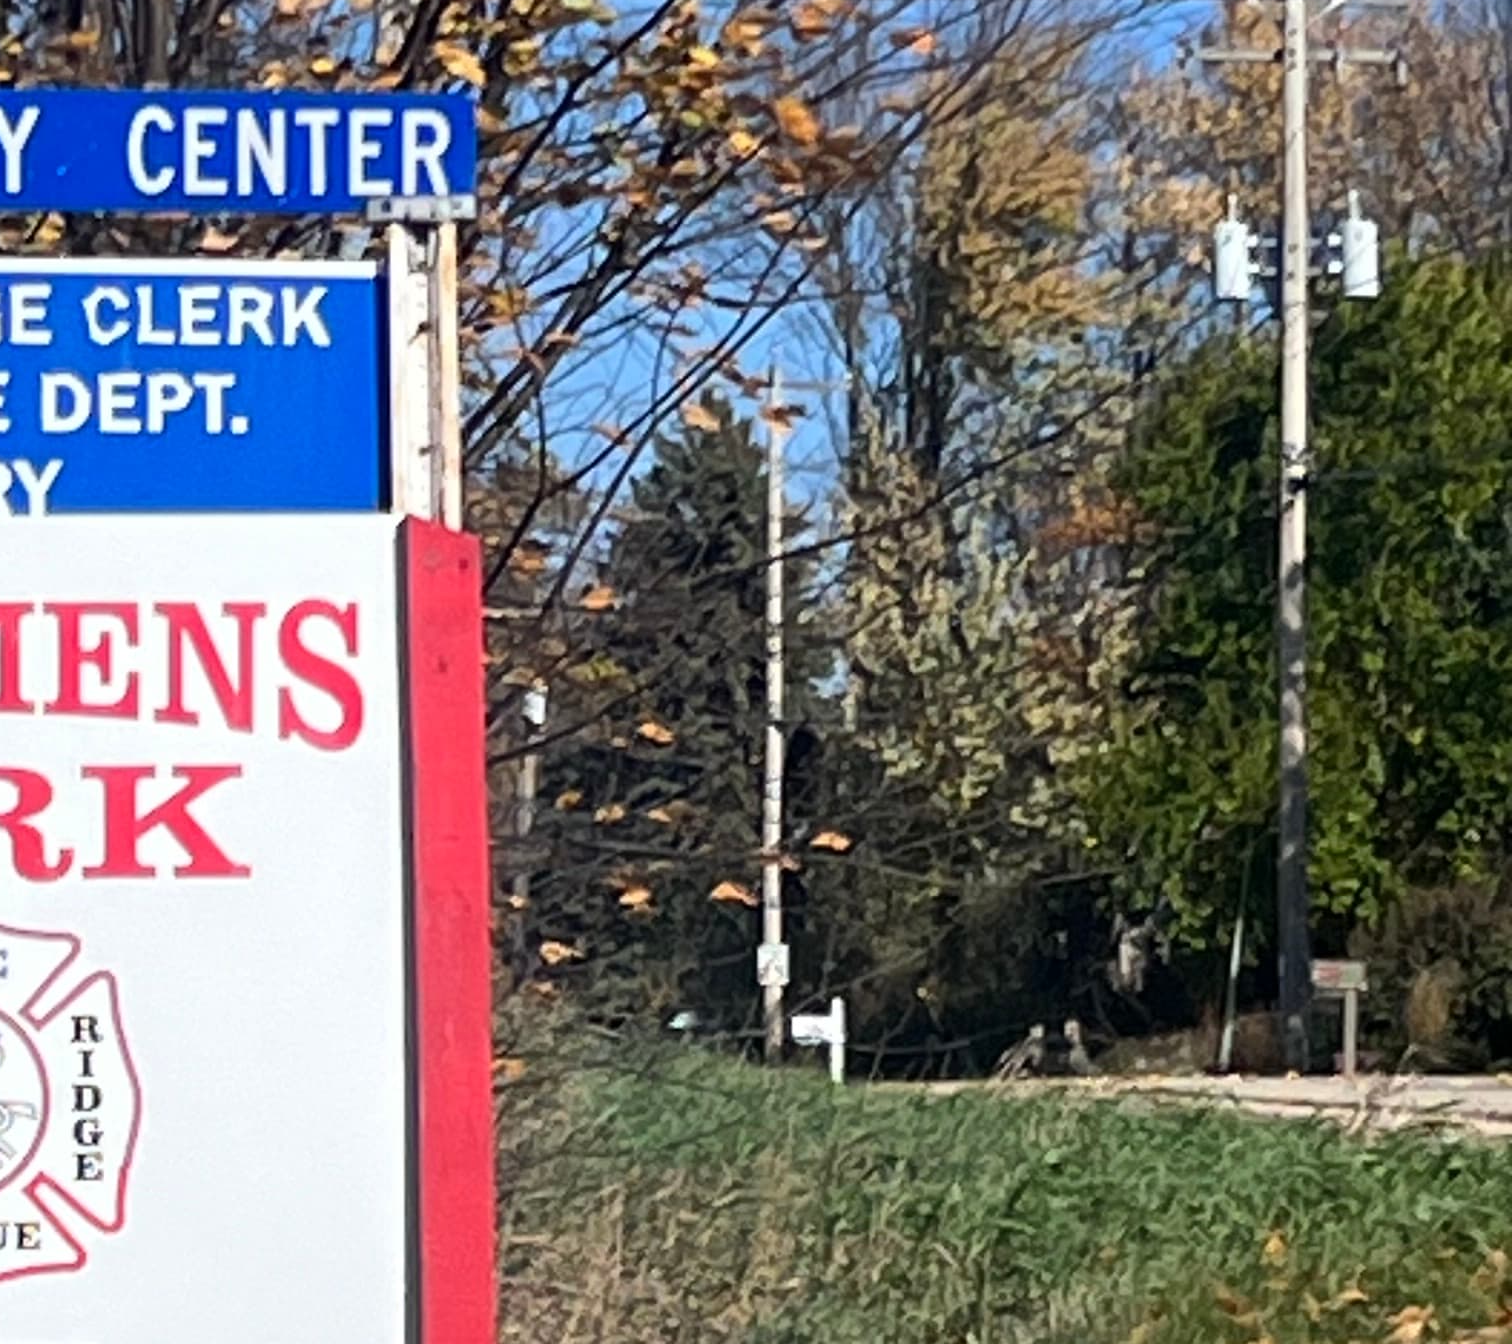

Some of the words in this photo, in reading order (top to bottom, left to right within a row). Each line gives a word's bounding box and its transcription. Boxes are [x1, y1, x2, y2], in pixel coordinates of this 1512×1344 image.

[125, 106, 453, 198] CENTER
[82, 287, 330, 348] CLERK
[39, 372, 249, 435] DEPT.
[71, 1015, 103, 1182] RIDGE
